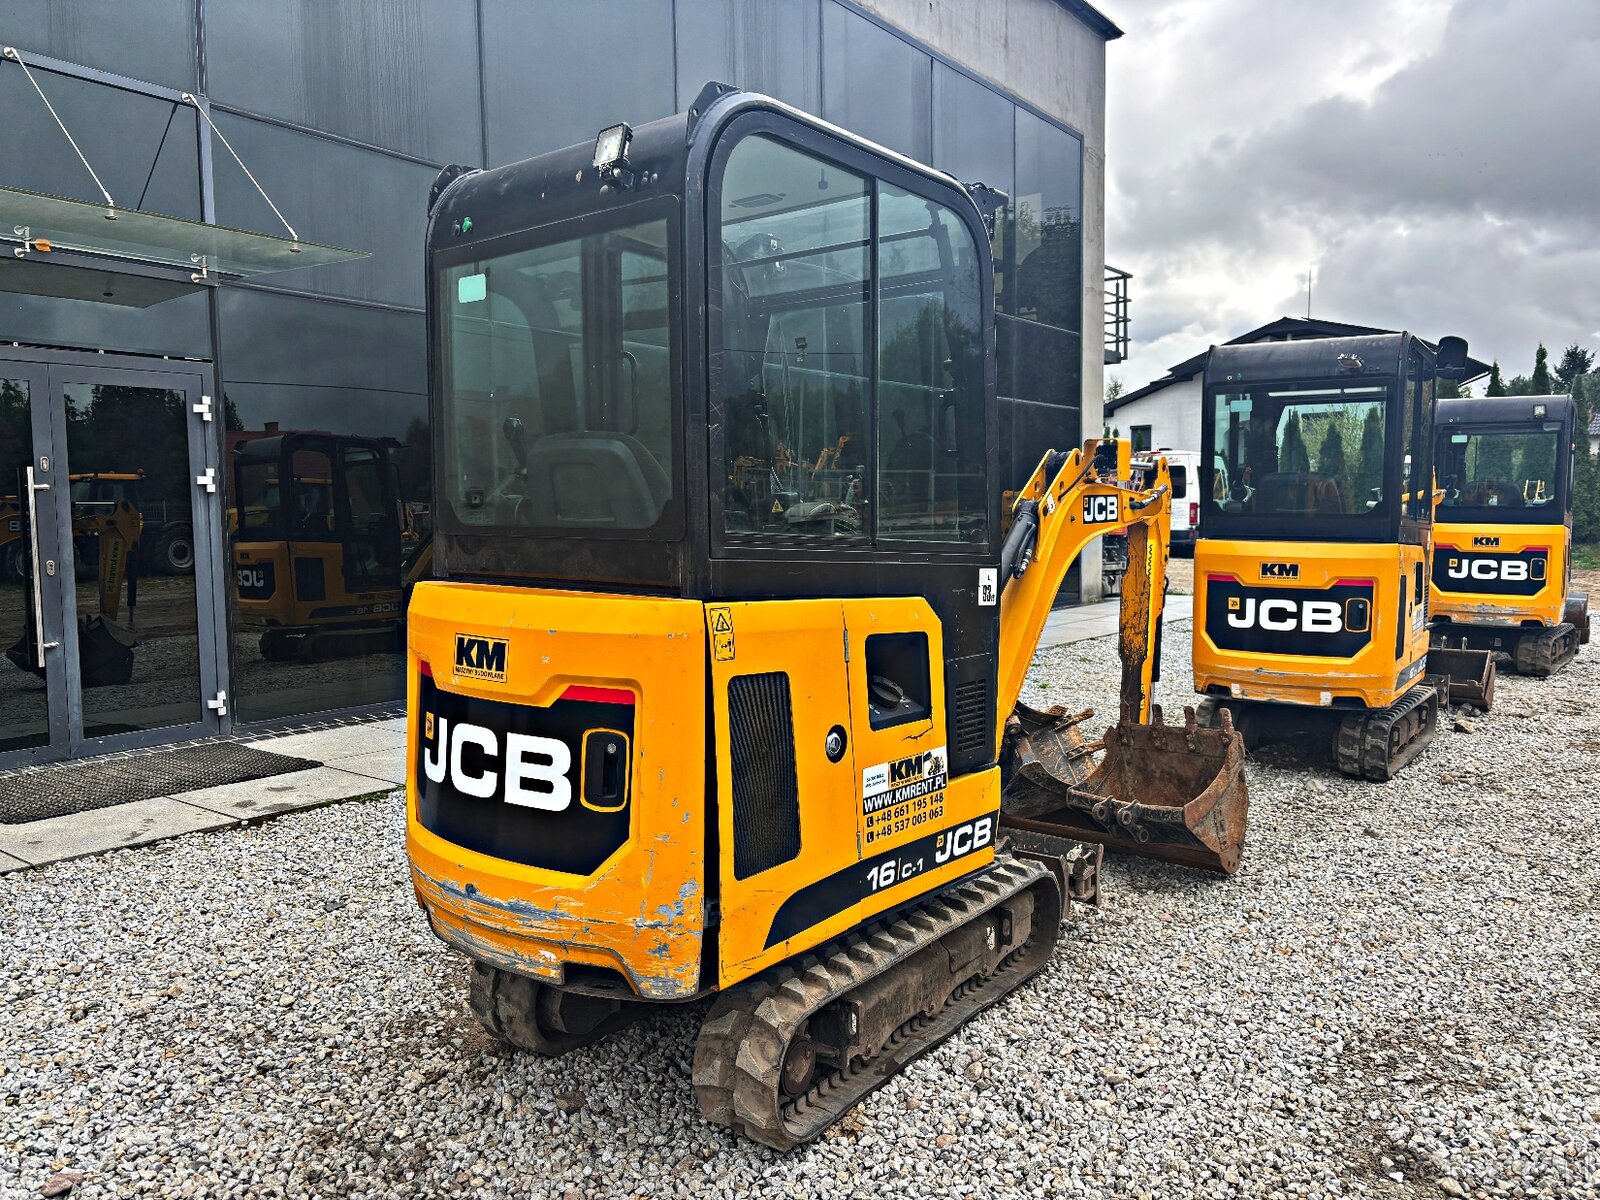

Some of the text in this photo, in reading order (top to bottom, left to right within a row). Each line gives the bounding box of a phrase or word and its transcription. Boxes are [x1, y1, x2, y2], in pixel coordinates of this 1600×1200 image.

[1084, 496, 1118, 522] JCB
[1473, 537, 1500, 546] KM
[1261, 564, 1299, 577] KM
[1448, 559, 1528, 581] JCB
[1227, 598, 1343, 634] JCB
[456, 637, 506, 673] KM
[424, 716, 572, 812] JCB
[890, 755, 923, 783] KM
[863, 774, 947, 813] WWW.KMRENT.PL
[875, 792, 944, 825] +48 661 195 148
[875, 805, 944, 840] +48 537 003 063
[935, 817, 992, 863] JCB
